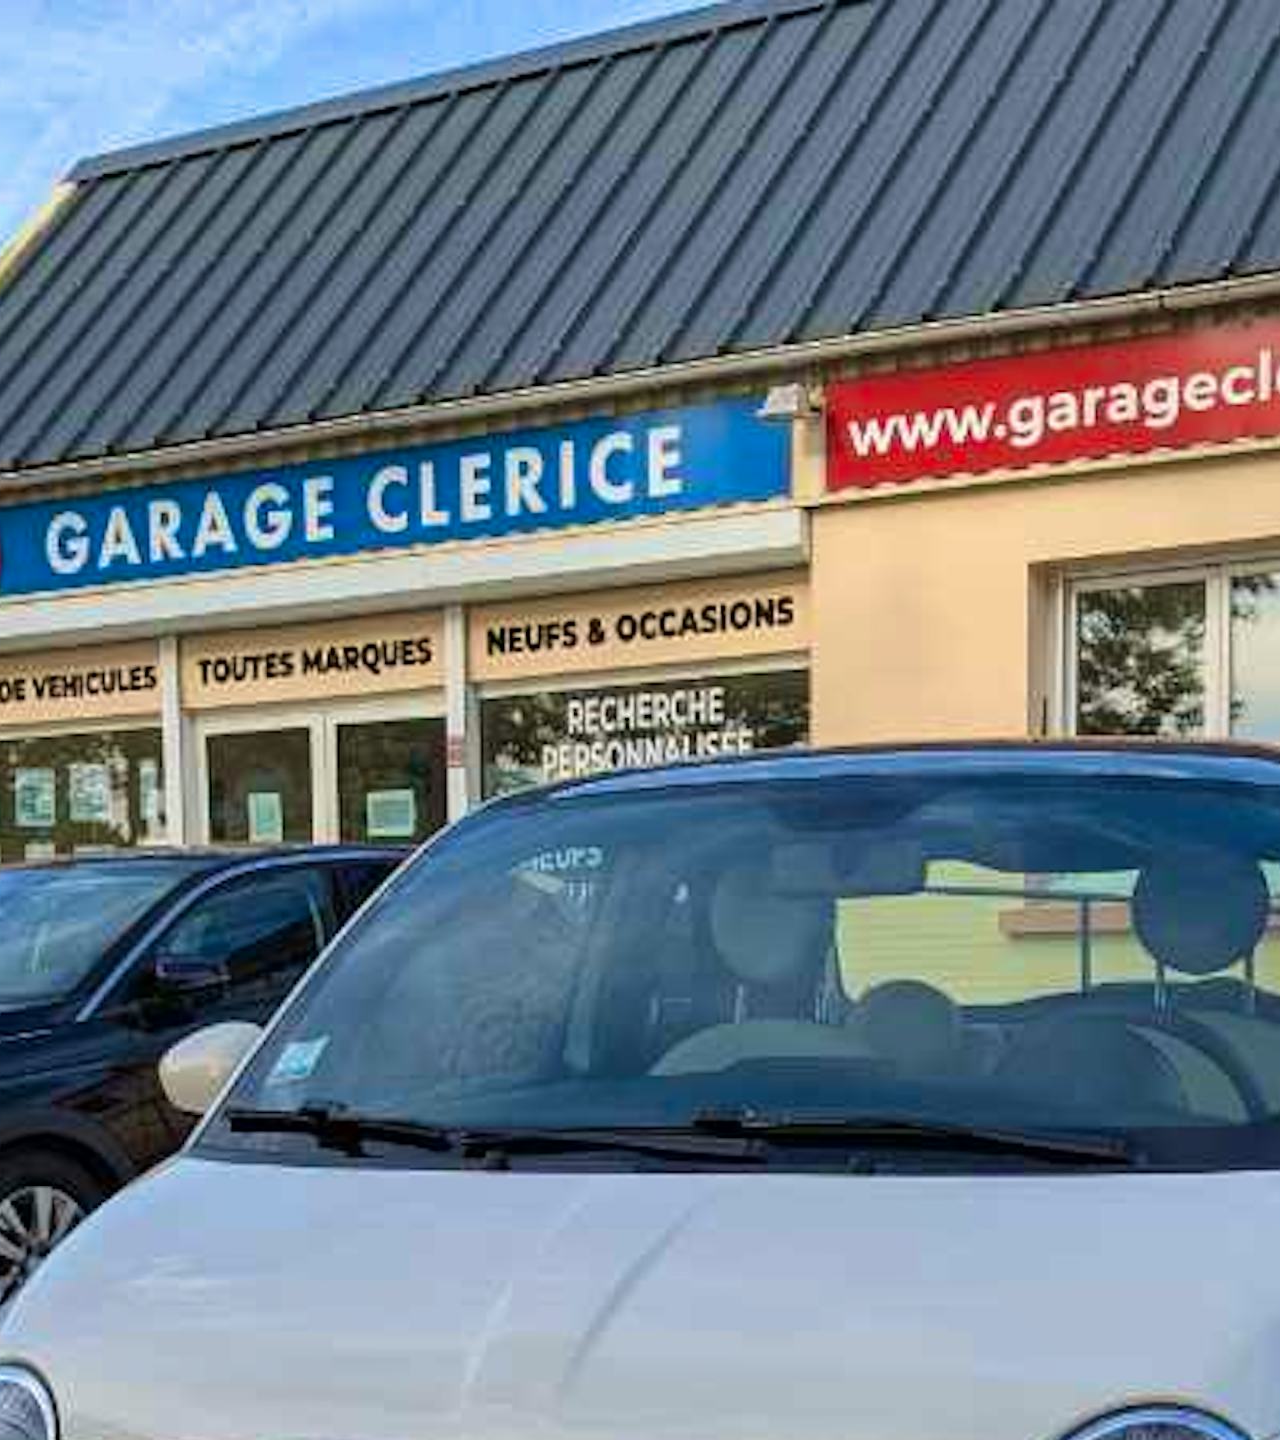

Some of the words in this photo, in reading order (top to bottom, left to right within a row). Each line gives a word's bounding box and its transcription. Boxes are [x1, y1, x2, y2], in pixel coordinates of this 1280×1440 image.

[45, 475, 335, 576] GARAGE
[366, 424, 684, 534] CLERICE
[487, 618, 578, 656] NEUFS
[588, 617, 606, 646] &
[618, 595, 795, 642] OCCASIONS
[33, 665, 158, 699] VEHICULES
[197, 652, 295, 686] TOUTES
[302, 637, 433, 675] MARQUES
[568, 686, 726, 735] RECHERCHE
